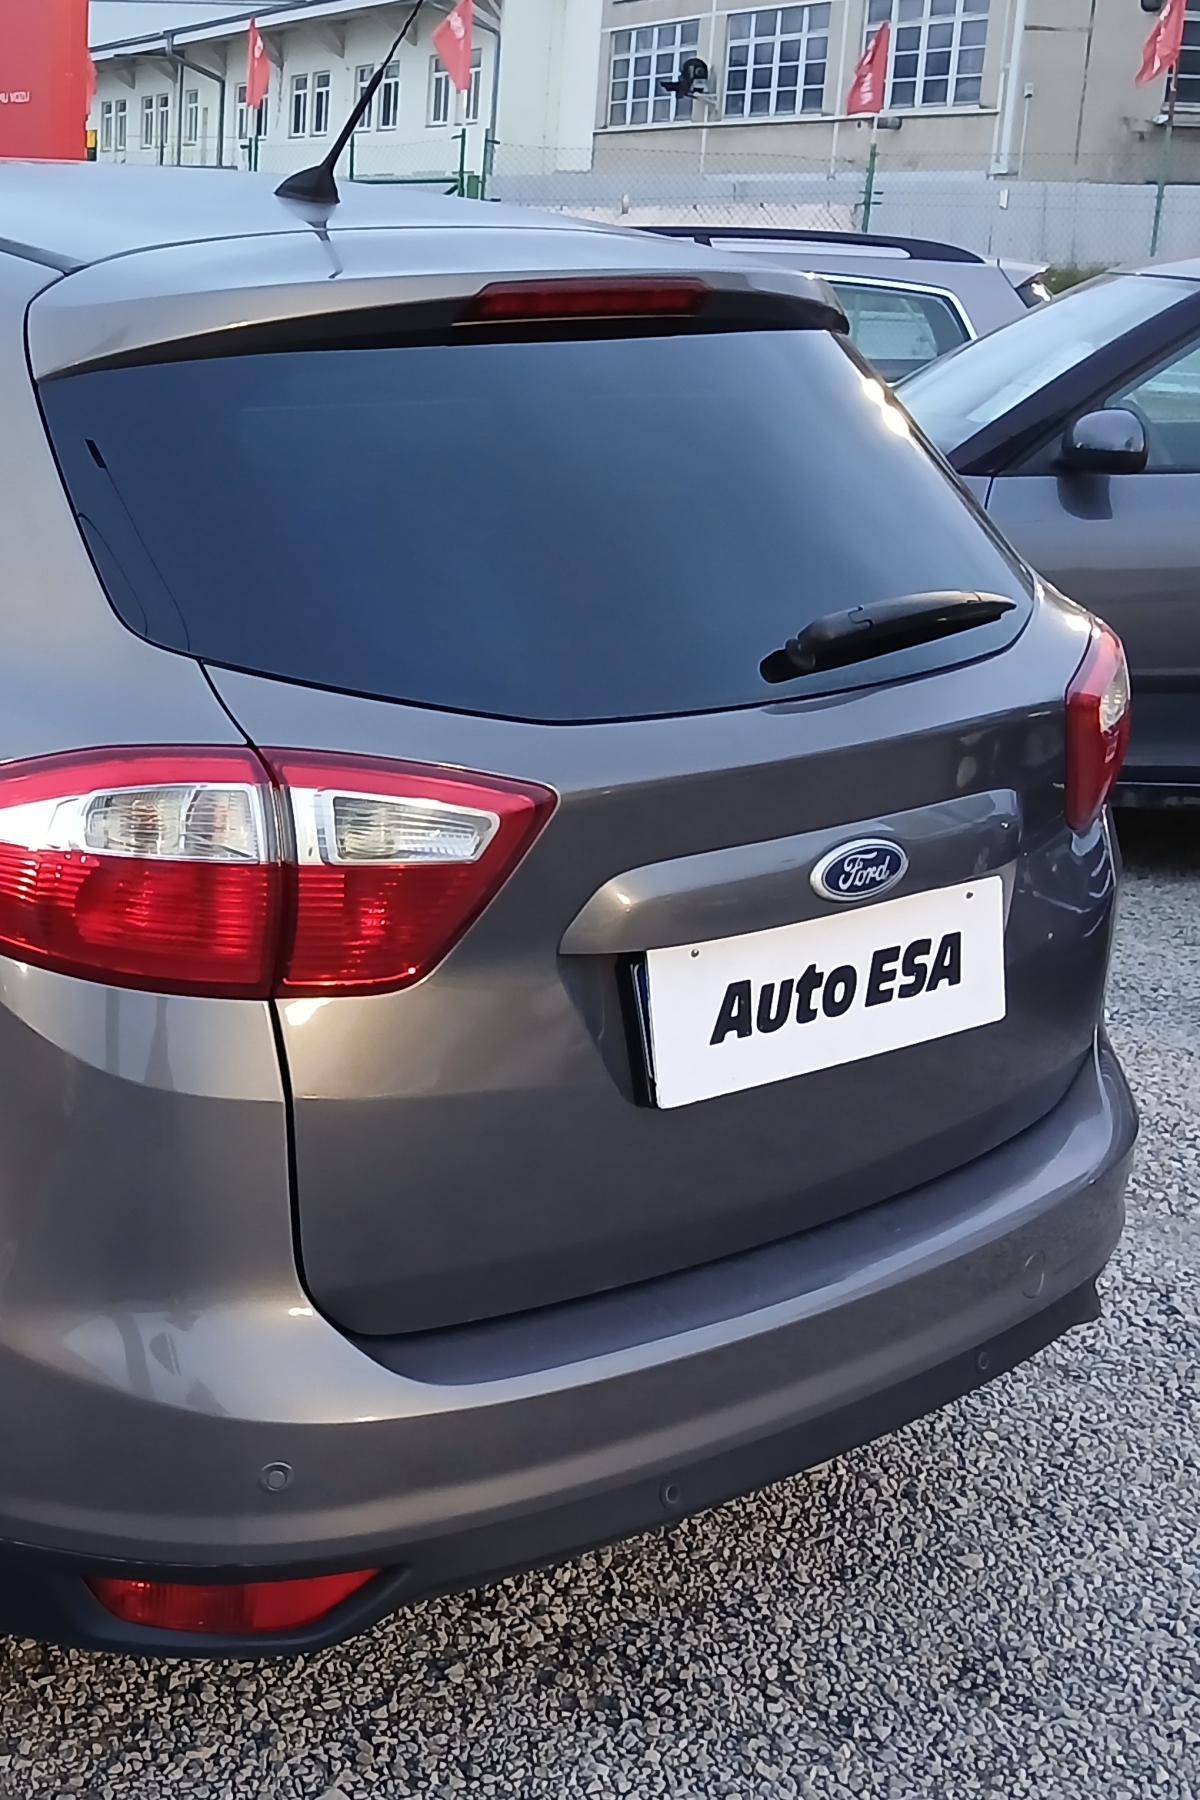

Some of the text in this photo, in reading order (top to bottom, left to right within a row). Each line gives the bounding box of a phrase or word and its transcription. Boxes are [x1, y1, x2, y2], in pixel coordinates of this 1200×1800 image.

[838, 851, 892, 890] Ford
[709, 931, 962, 1046] Auto ESA
